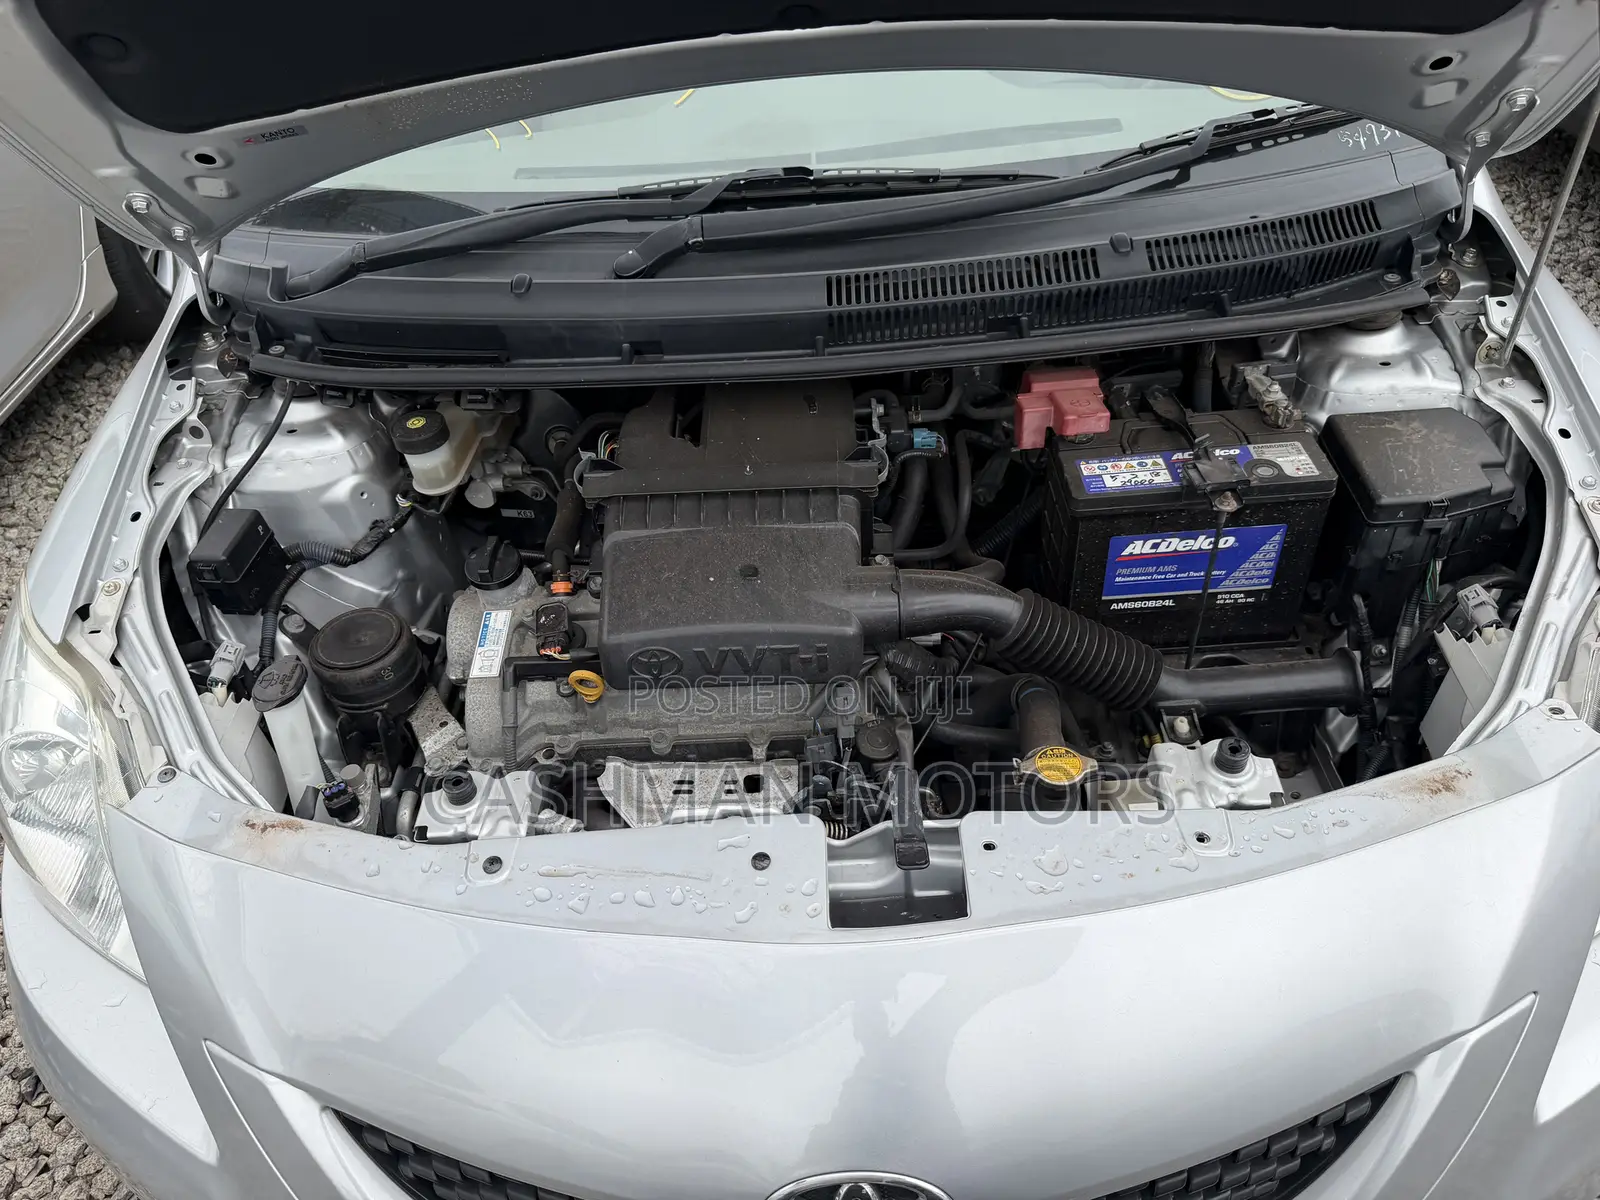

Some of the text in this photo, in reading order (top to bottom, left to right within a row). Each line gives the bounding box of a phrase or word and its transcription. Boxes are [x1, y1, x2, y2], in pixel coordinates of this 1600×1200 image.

[260, 127, 295, 139] KANTO
[1120, 535, 1237, 556] ACDelco
[1115, 564, 1178, 576] PREMIUM AMS
[1114, 574, 1152, 582] Maintenance
[1110, 599, 1176, 610] AMS60B24L
[692, 643, 829, 674] VVT-i
